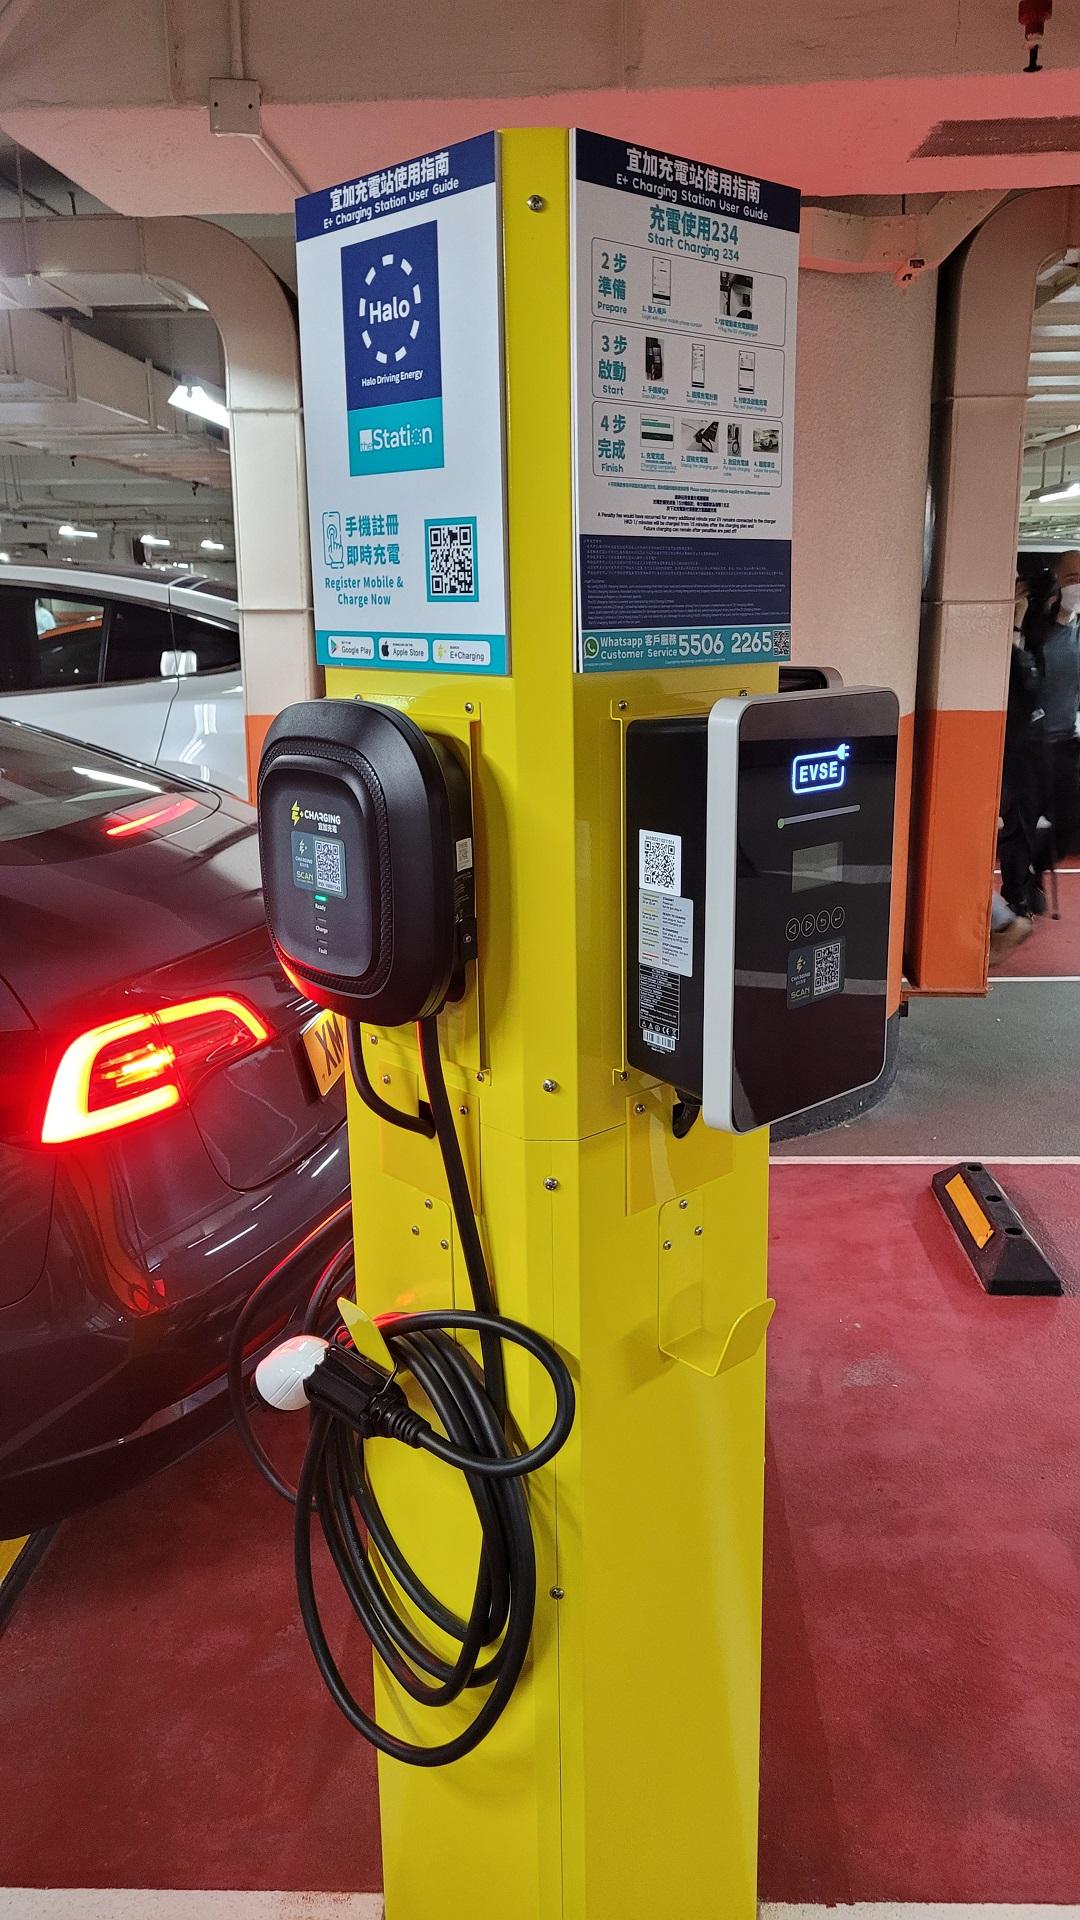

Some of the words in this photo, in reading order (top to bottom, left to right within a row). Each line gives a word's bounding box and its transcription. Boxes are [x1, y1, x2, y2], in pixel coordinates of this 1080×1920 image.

[330, 152, 450, 212] 宜加充電站使用指南
[626, 147, 760, 204] 宜加充電站使用指南
[324, 218, 334, 228] E+
[336, 206, 372, 226] Charging
[374, 196, 406, 213] Station
[408, 187, 429, 202] User
[432, 178, 460, 194] Guide
[616, 174, 628, 186] E+
[632, 177, 678, 202] Charging
[682, 190, 716, 208] Station
[720, 198, 740, 214] User
[743, 204, 768, 222] Guide
[650, 204, 738, 246] 充電使用234
[648, 234, 674, 248] Start
[677, 239, 720, 262] Charging
[722, 250, 740, 262] 234
[602, 252, 610, 270] 2
[613, 253, 628, 272] 步
[598, 276, 626, 300] 準備
[369, 296, 410, 324] Halo
[598, 301, 627, 314] Prepare
[602, 335, 610, 352] 3
[613, 335, 628, 356] 步
[361, 376, 376, 387] Halo
[376, 372, 400, 386] Driving
[400, 369, 423, 382] Energy
[602, 384, 624, 396] Start
[600, 415, 609, 431] 4
[612, 414, 626, 434] 步
[373, 424, 433, 450] Station
[598, 439, 626, 460] 完成
[601, 462, 624, 473] Finish
[346, 514, 399, 538] 手機註冊
[346, 543, 400, 566] 即時充電
[325, 576, 360, 590] Register
[364, 576, 394, 588] Mobile
[396, 577, 404, 588] &
[338, 593, 368, 608] Charge
[371, 594, 391, 606] Now
[342, 646, 359, 656] Google
[360, 646, 372, 656] Play
[392, 648, 408, 657] Apple
[600, 636, 642, 649] Whatsapp
[644, 634, 677, 646] 客戶服務
[679, 634, 724, 656] 5506
[731, 632, 771, 654] 2265
[601, 649, 643, 660] Customer
[647, 648, 678, 658] Service
[800, 761, 838, 783] EVSE
[296, 871, 314, 881] SCAN
[315, 903, 326, 912] Ready
[316, 925, 328, 934] Charge
[791, 988, 810, 999] SCAN
